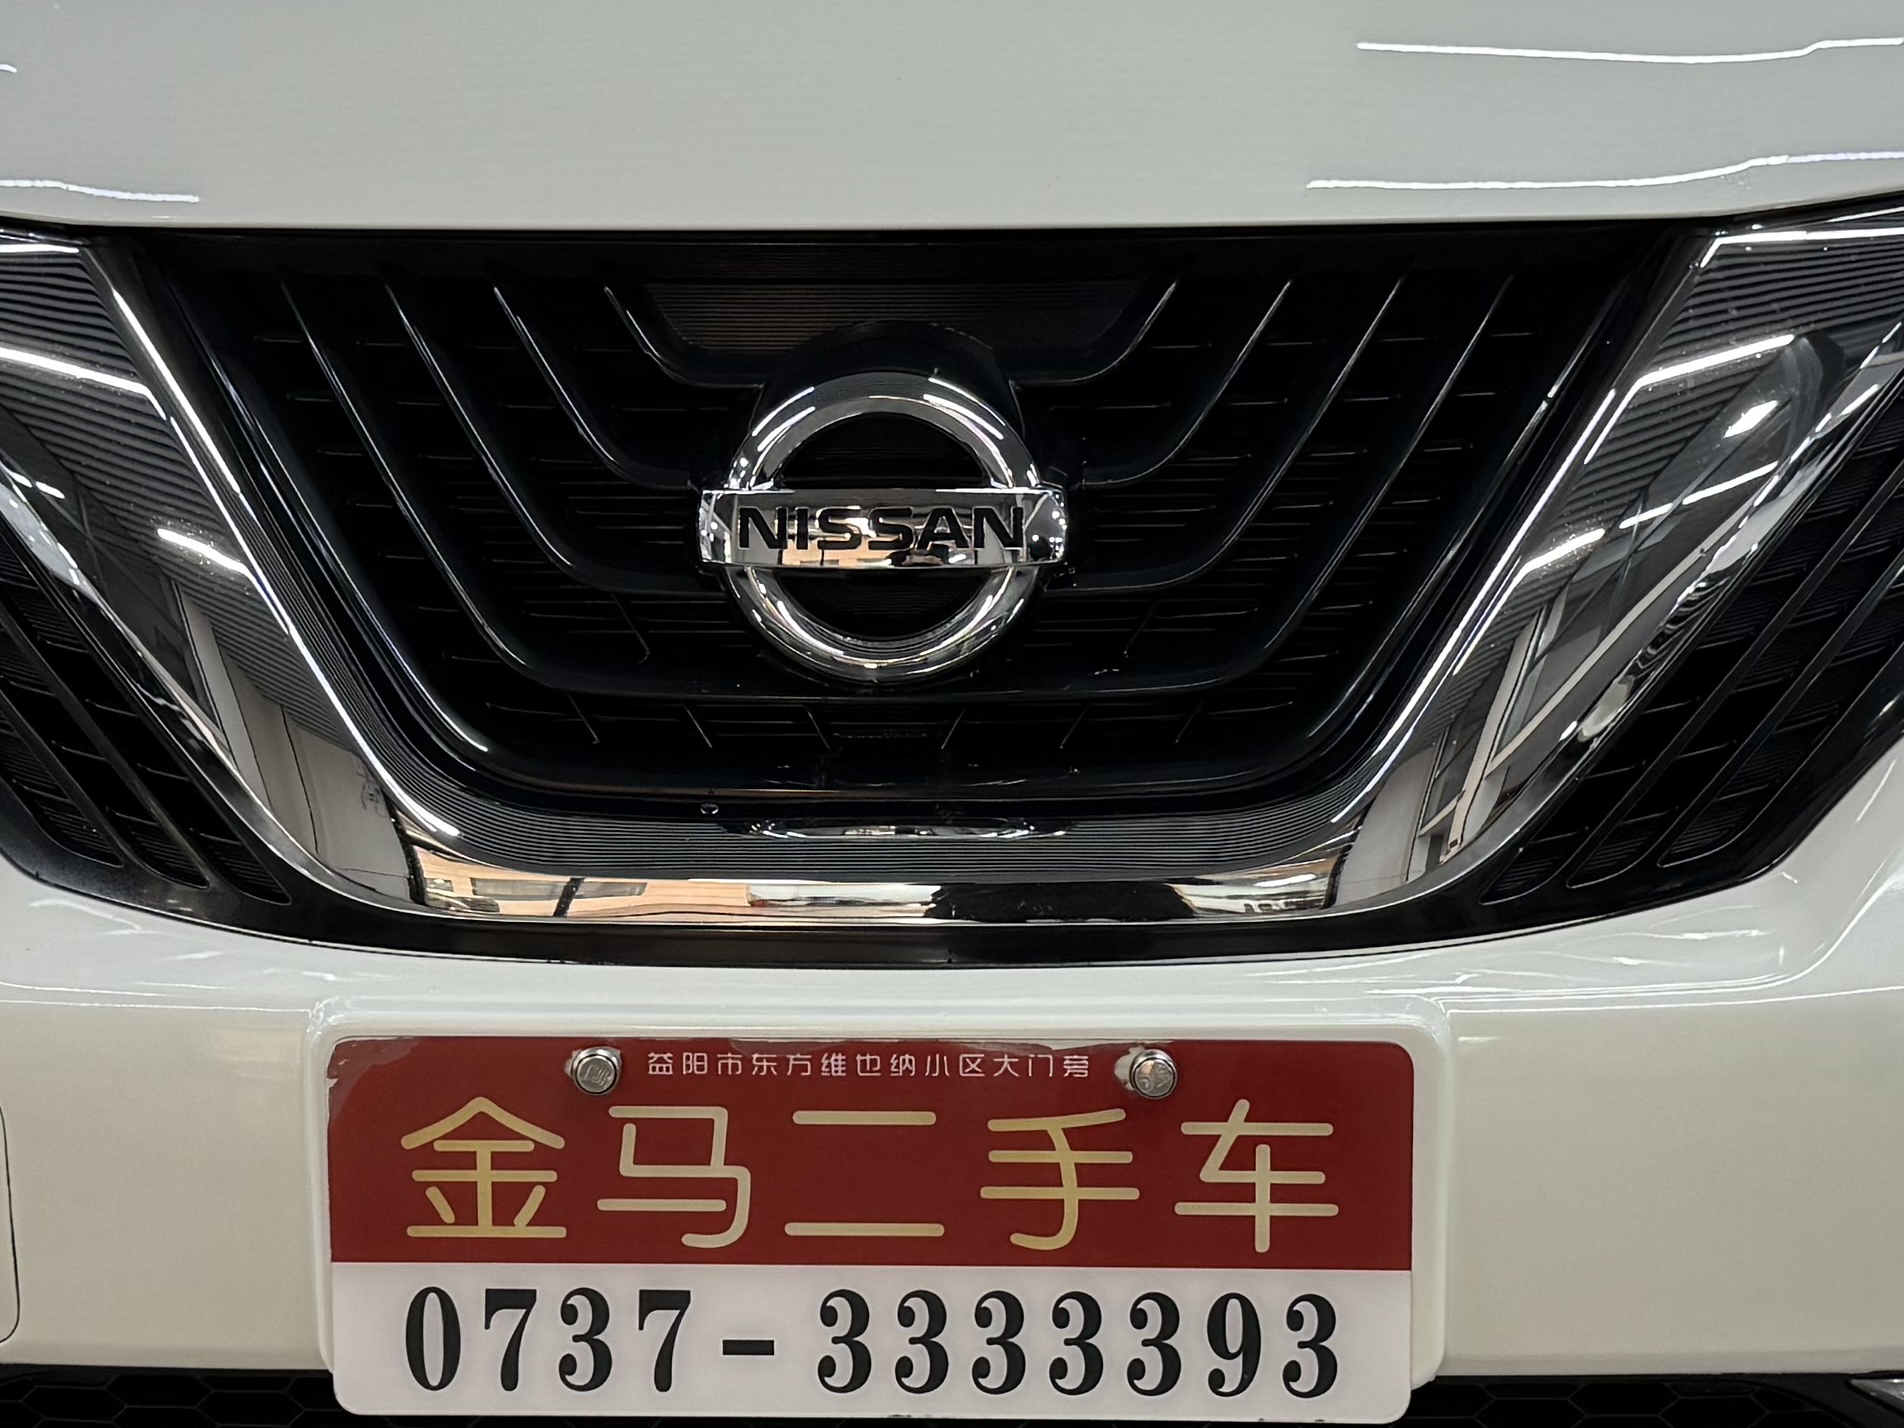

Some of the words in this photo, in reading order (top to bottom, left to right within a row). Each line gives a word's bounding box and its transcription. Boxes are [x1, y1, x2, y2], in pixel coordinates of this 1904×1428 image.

[738, 507, 1024, 550] NISSAN
[647, 1052, 1090, 1078] 益阳市东方维也纳小区大门旁
[401, 1097, 1339, 1254] 金马二手车
[404, 1286, 1339, 1398] 0737-3333393
